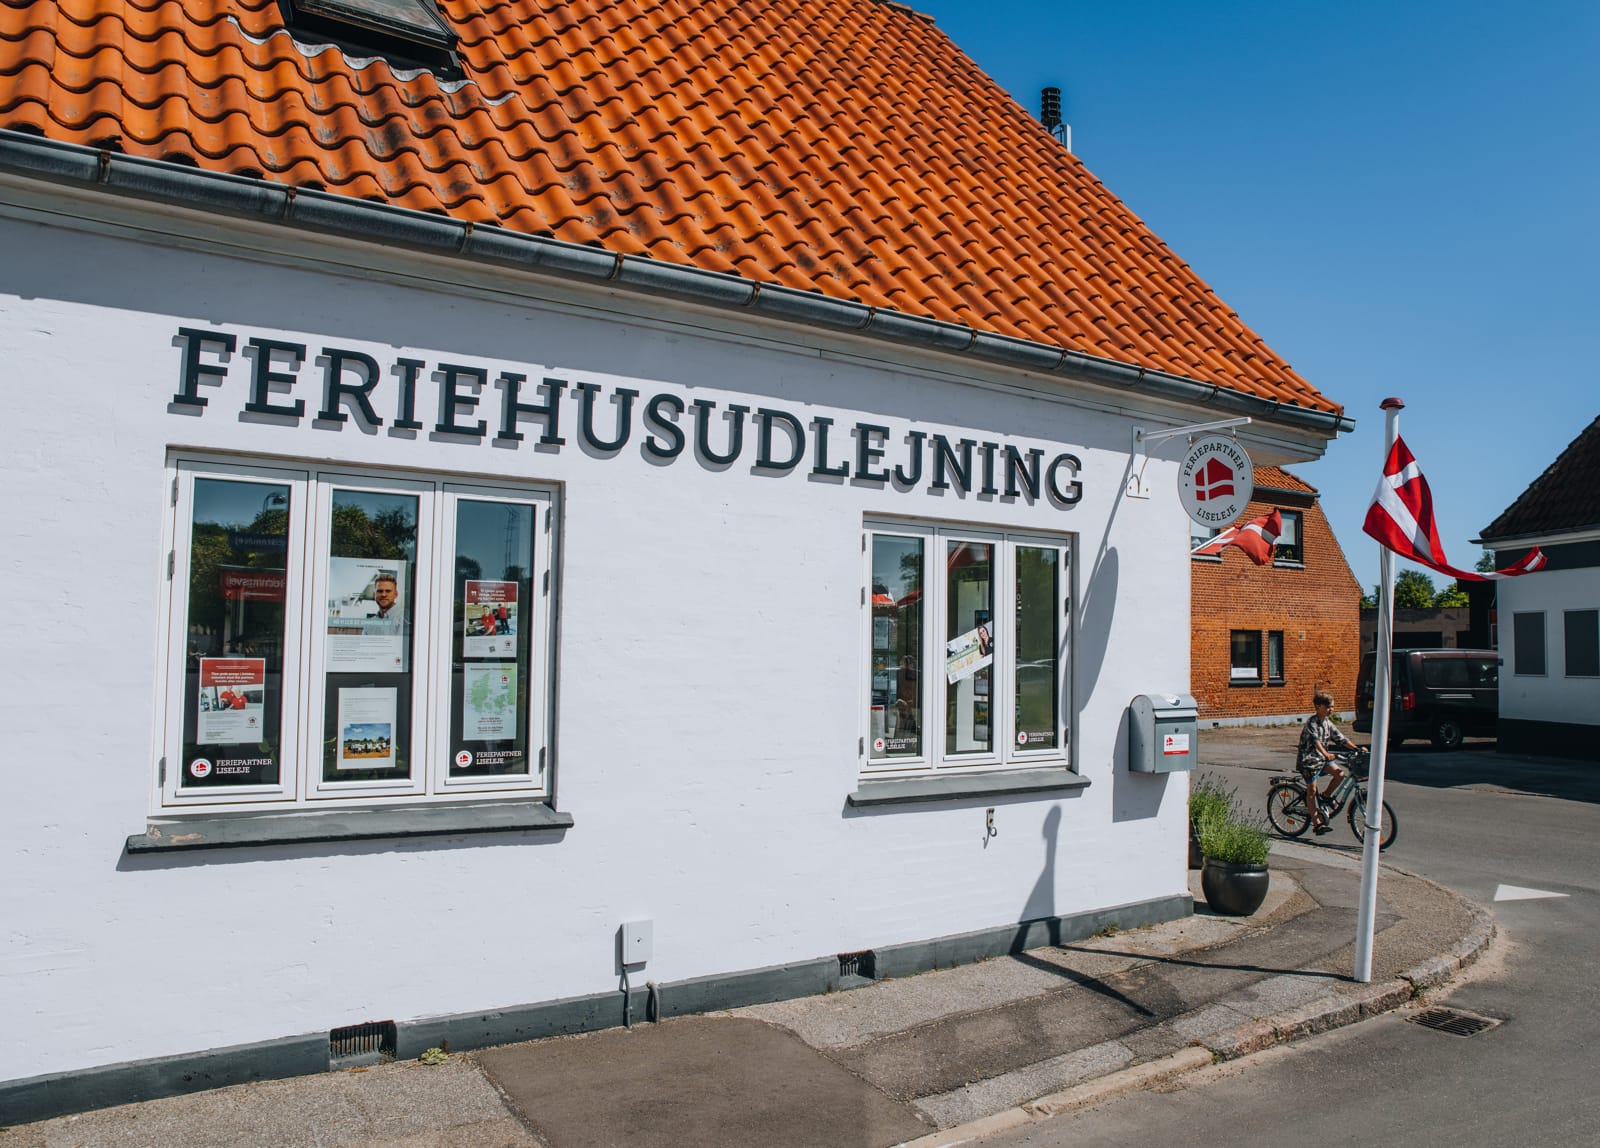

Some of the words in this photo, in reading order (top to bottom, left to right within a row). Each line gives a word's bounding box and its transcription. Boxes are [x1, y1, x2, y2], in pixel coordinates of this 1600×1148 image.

[174, 327, 1083, 505] FERIEHUSUDLEJNING
[1184, 443, 1244, 477] FERIEPARTNER
[1196, 504, 1237, 521] LISELEJE
[476, 750, 522, 758] FERIEPARTNER
[216, 759, 273, 767] FERIEPARTNER
[476, 757, 505, 765] LISELEJE
[216, 766, 251, 775] LISELEJE
